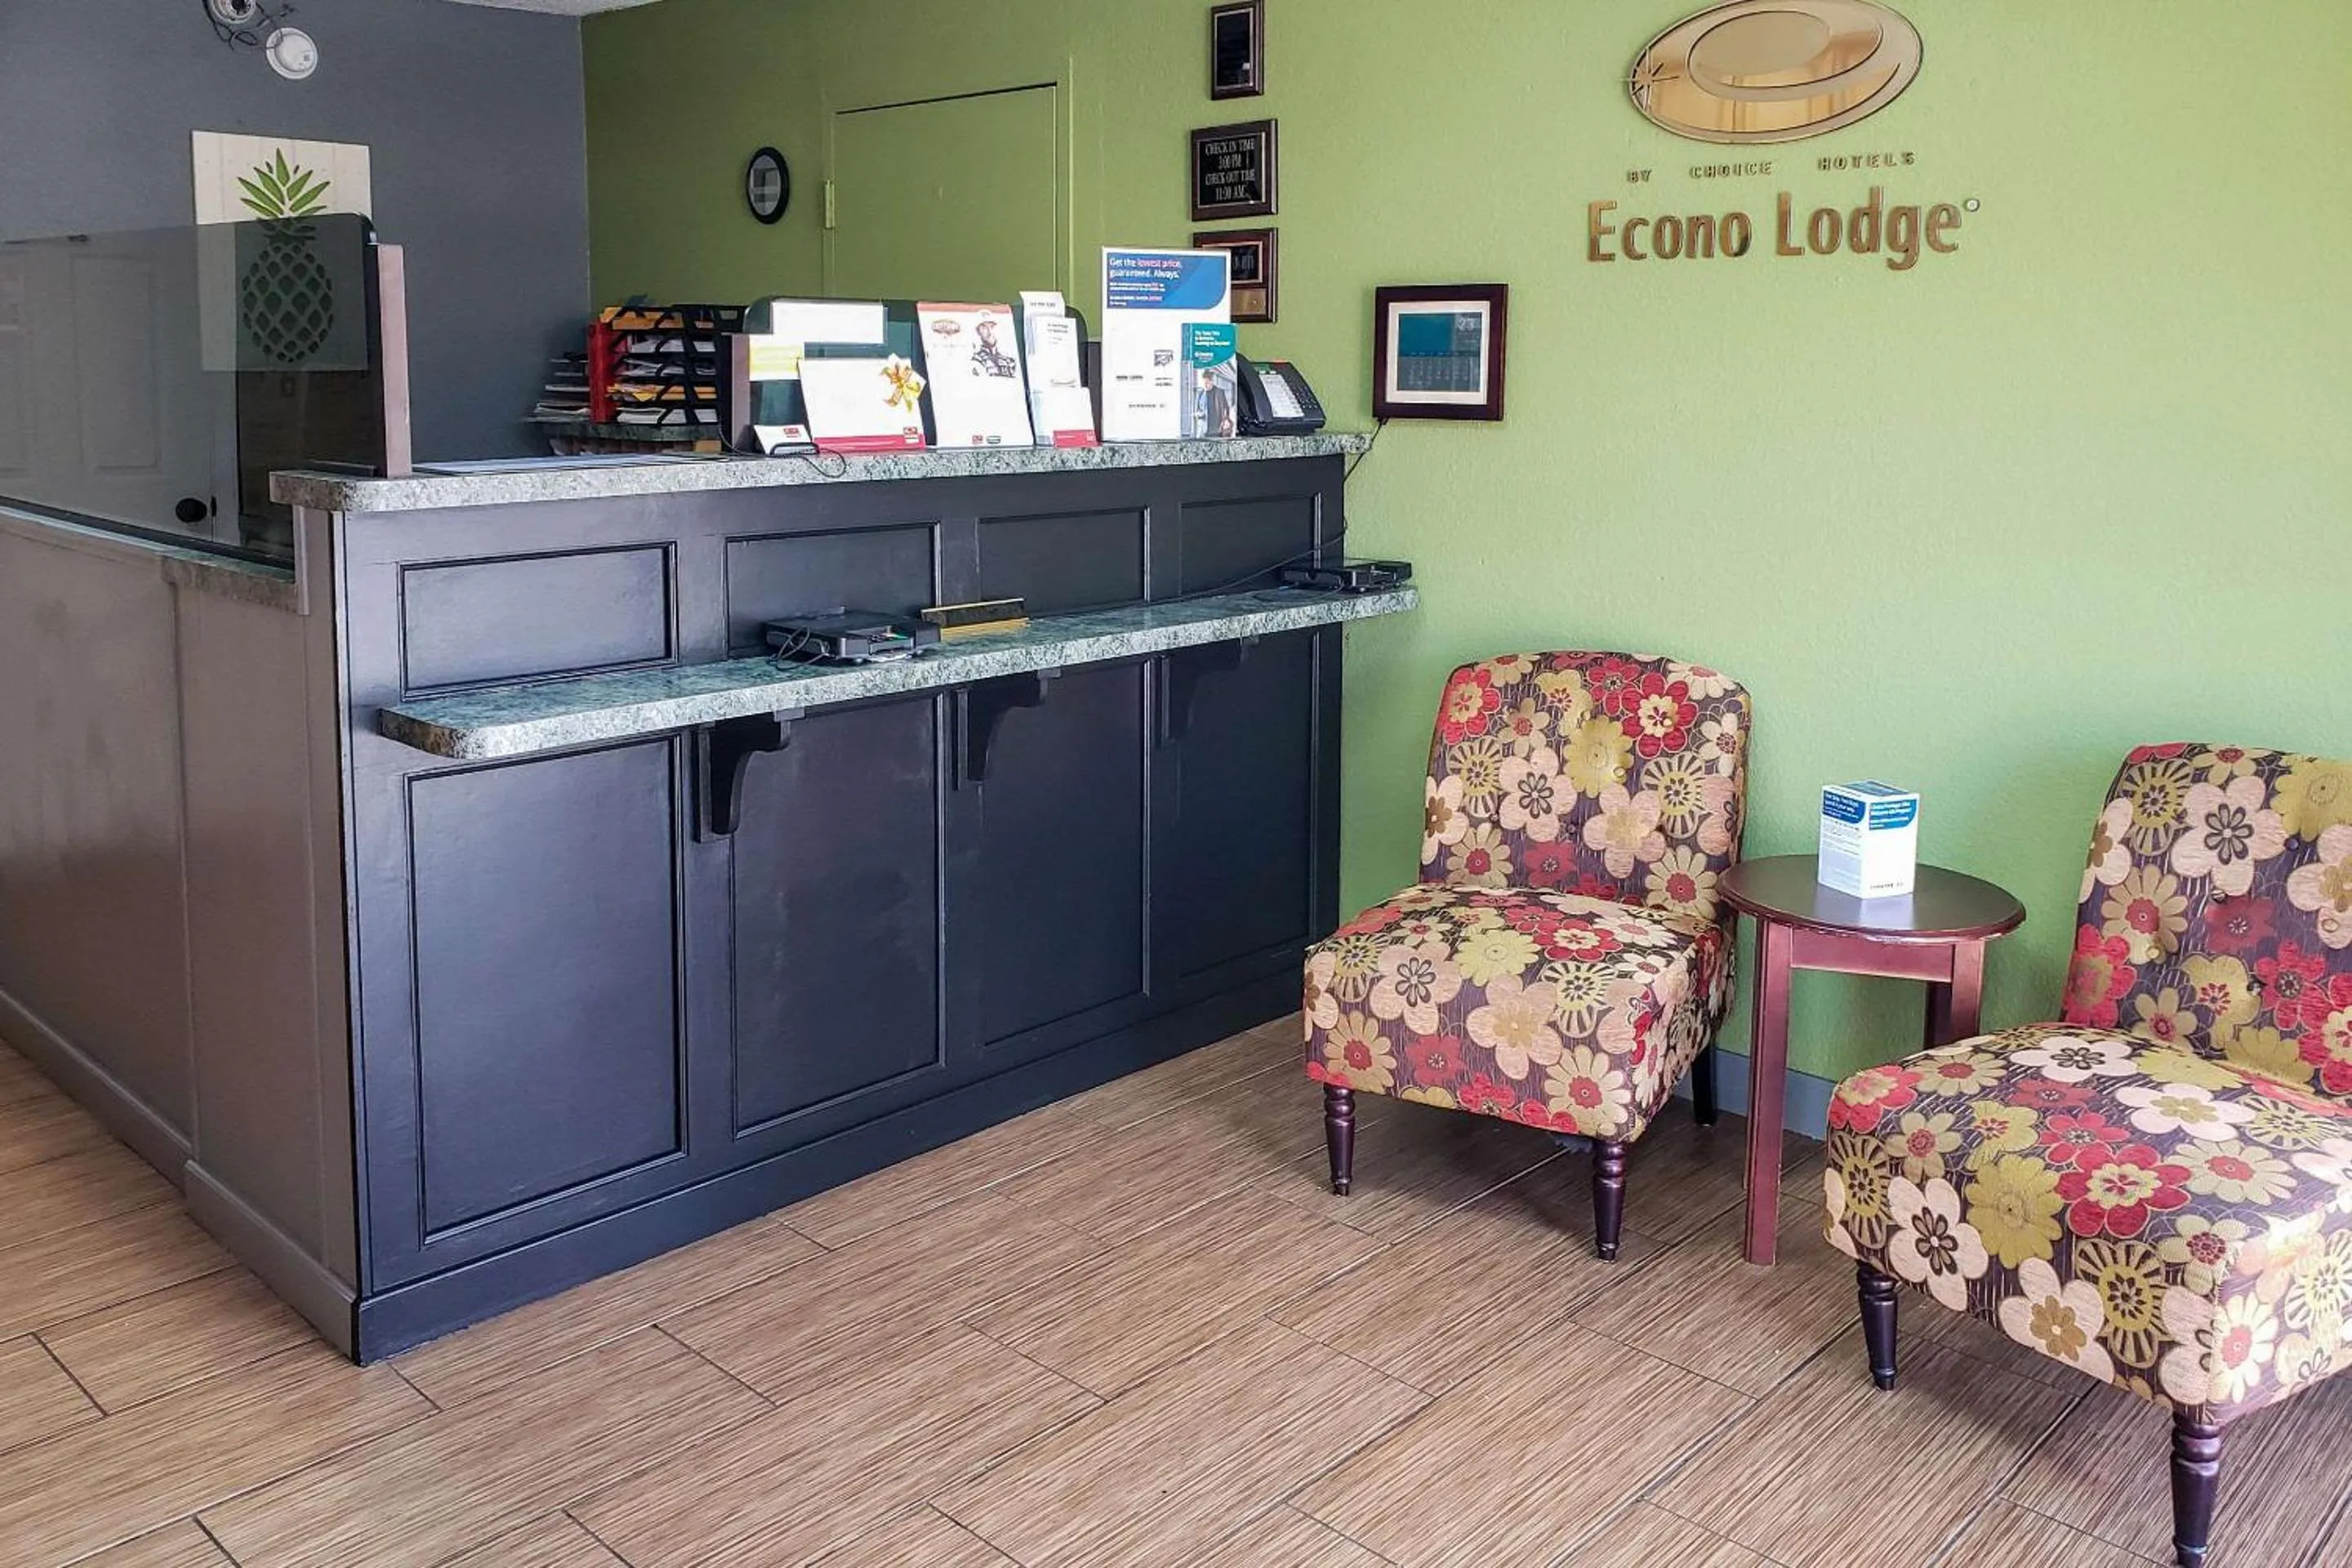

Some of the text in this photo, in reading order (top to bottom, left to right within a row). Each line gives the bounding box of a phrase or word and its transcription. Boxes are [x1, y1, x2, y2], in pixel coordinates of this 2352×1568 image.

[1238, 137, 1255, 151] TIME
[1627, 152, 1915, 183] BY CHOICE HOTELS
[1241, 168, 1255, 182] TIME
[1587, 186, 1962, 271] Econo Lodge
[1109, 258, 1124, 267] Get
[1124, 258, 1136, 267] the
[1136, 259, 1160, 268] lowest
[1109, 269, 1152, 279] guaranteed.
